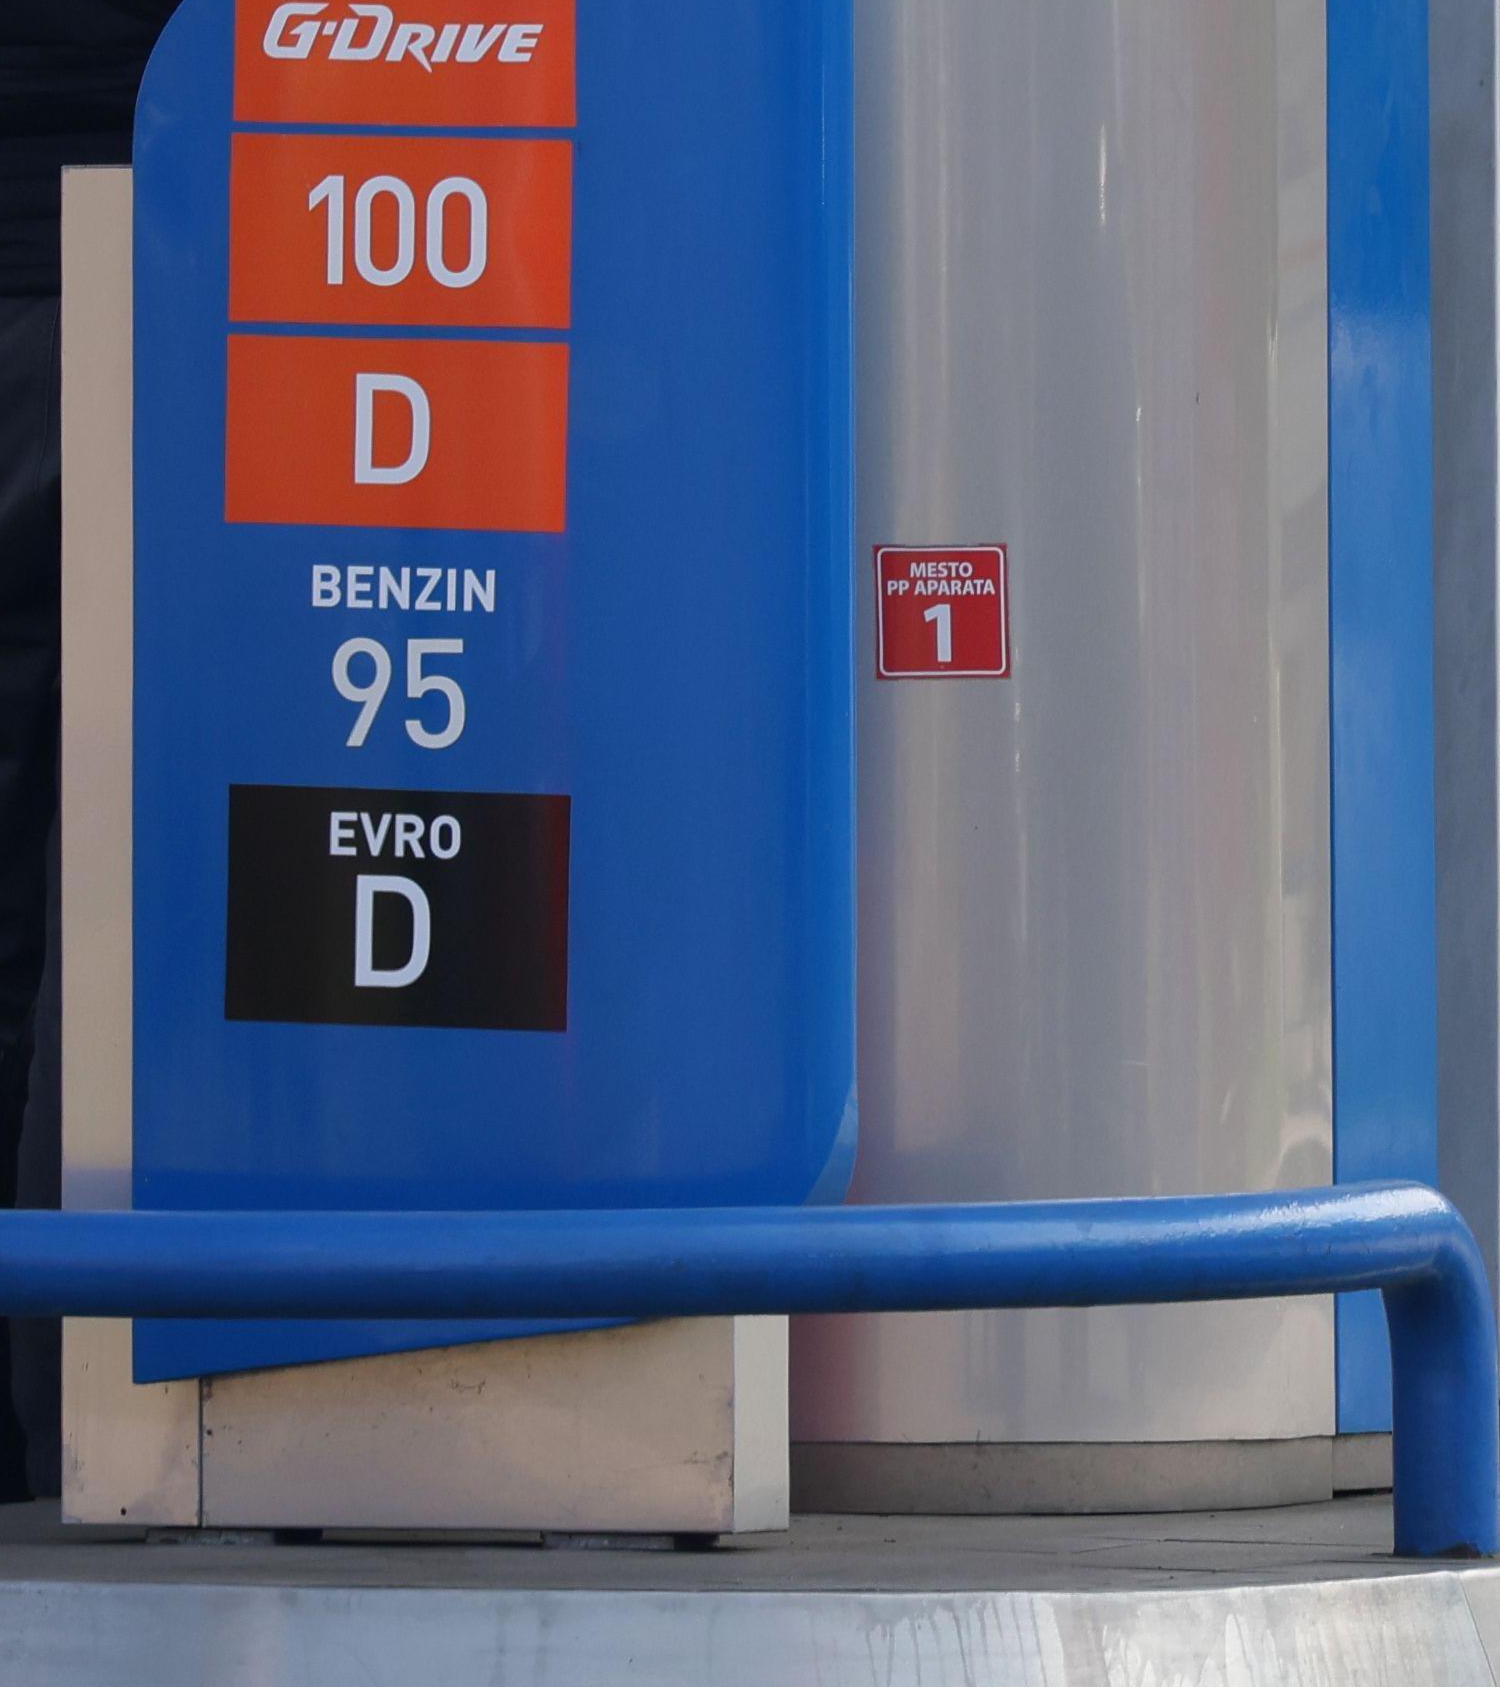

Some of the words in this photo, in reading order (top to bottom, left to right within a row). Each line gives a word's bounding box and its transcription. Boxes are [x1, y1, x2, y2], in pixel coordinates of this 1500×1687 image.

[308, 175, 488, 288] 100
[354, 373, 431, 485] D
[311, 563, 496, 613] BENZIN
[887, 580, 909, 596] PP
[914, 579, 996, 596] APARATA
[910, 562, 973, 578] MESTO
[924, 603, 952, 662] 1
[331, 638, 467, 749] 95
[329, 811, 463, 859] EVRO
[354, 874, 432, 988] D
